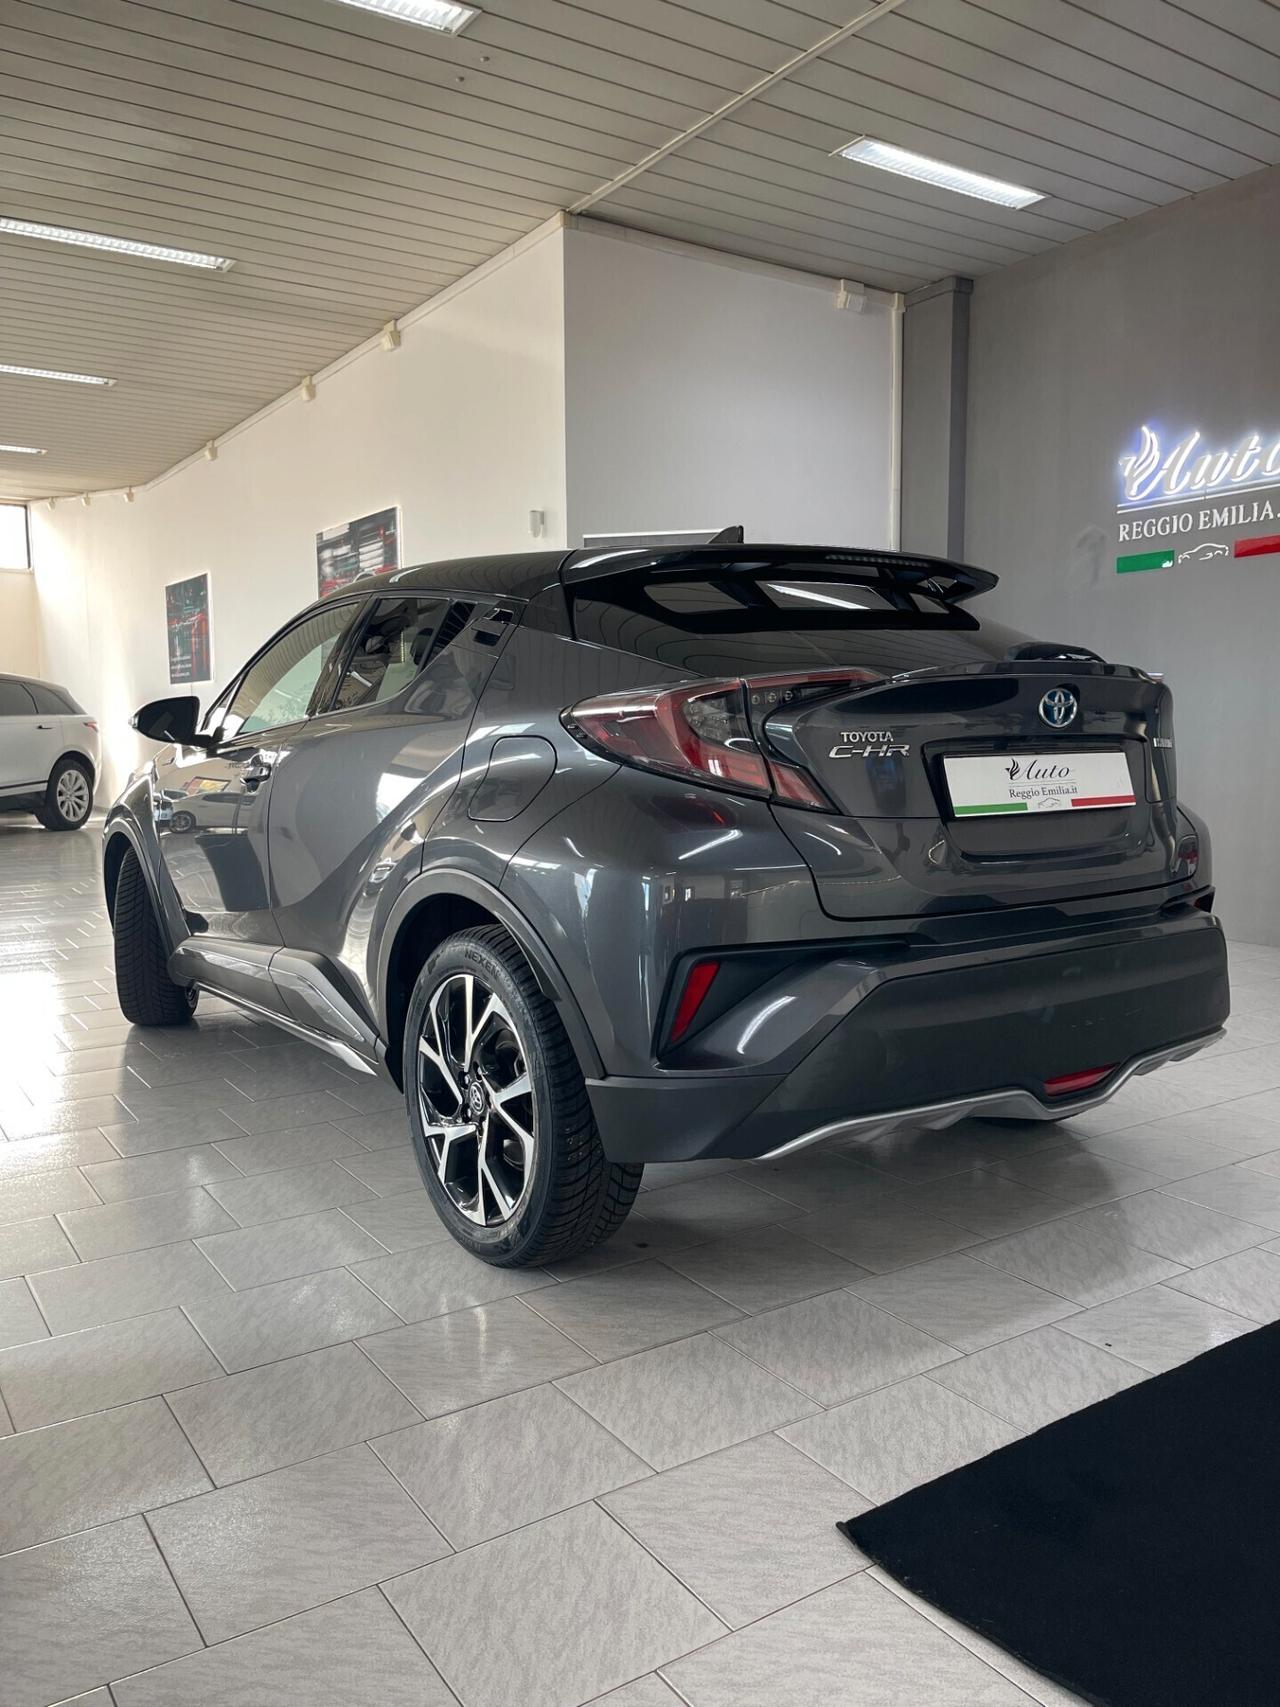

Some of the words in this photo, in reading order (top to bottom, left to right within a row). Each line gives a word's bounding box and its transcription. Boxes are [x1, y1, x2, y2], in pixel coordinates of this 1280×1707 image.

[1118, 513, 1193, 542] REGGIO
[840, 731, 894, 742] TOYOTA
[829, 744, 910, 758] C-HR
[1005, 758, 1070, 780] Auto
[1009, 787, 1040, 799] Reggio
[1041, 785, 1078, 796] Emilia.it
[464, 950, 501, 976] NEXEN
